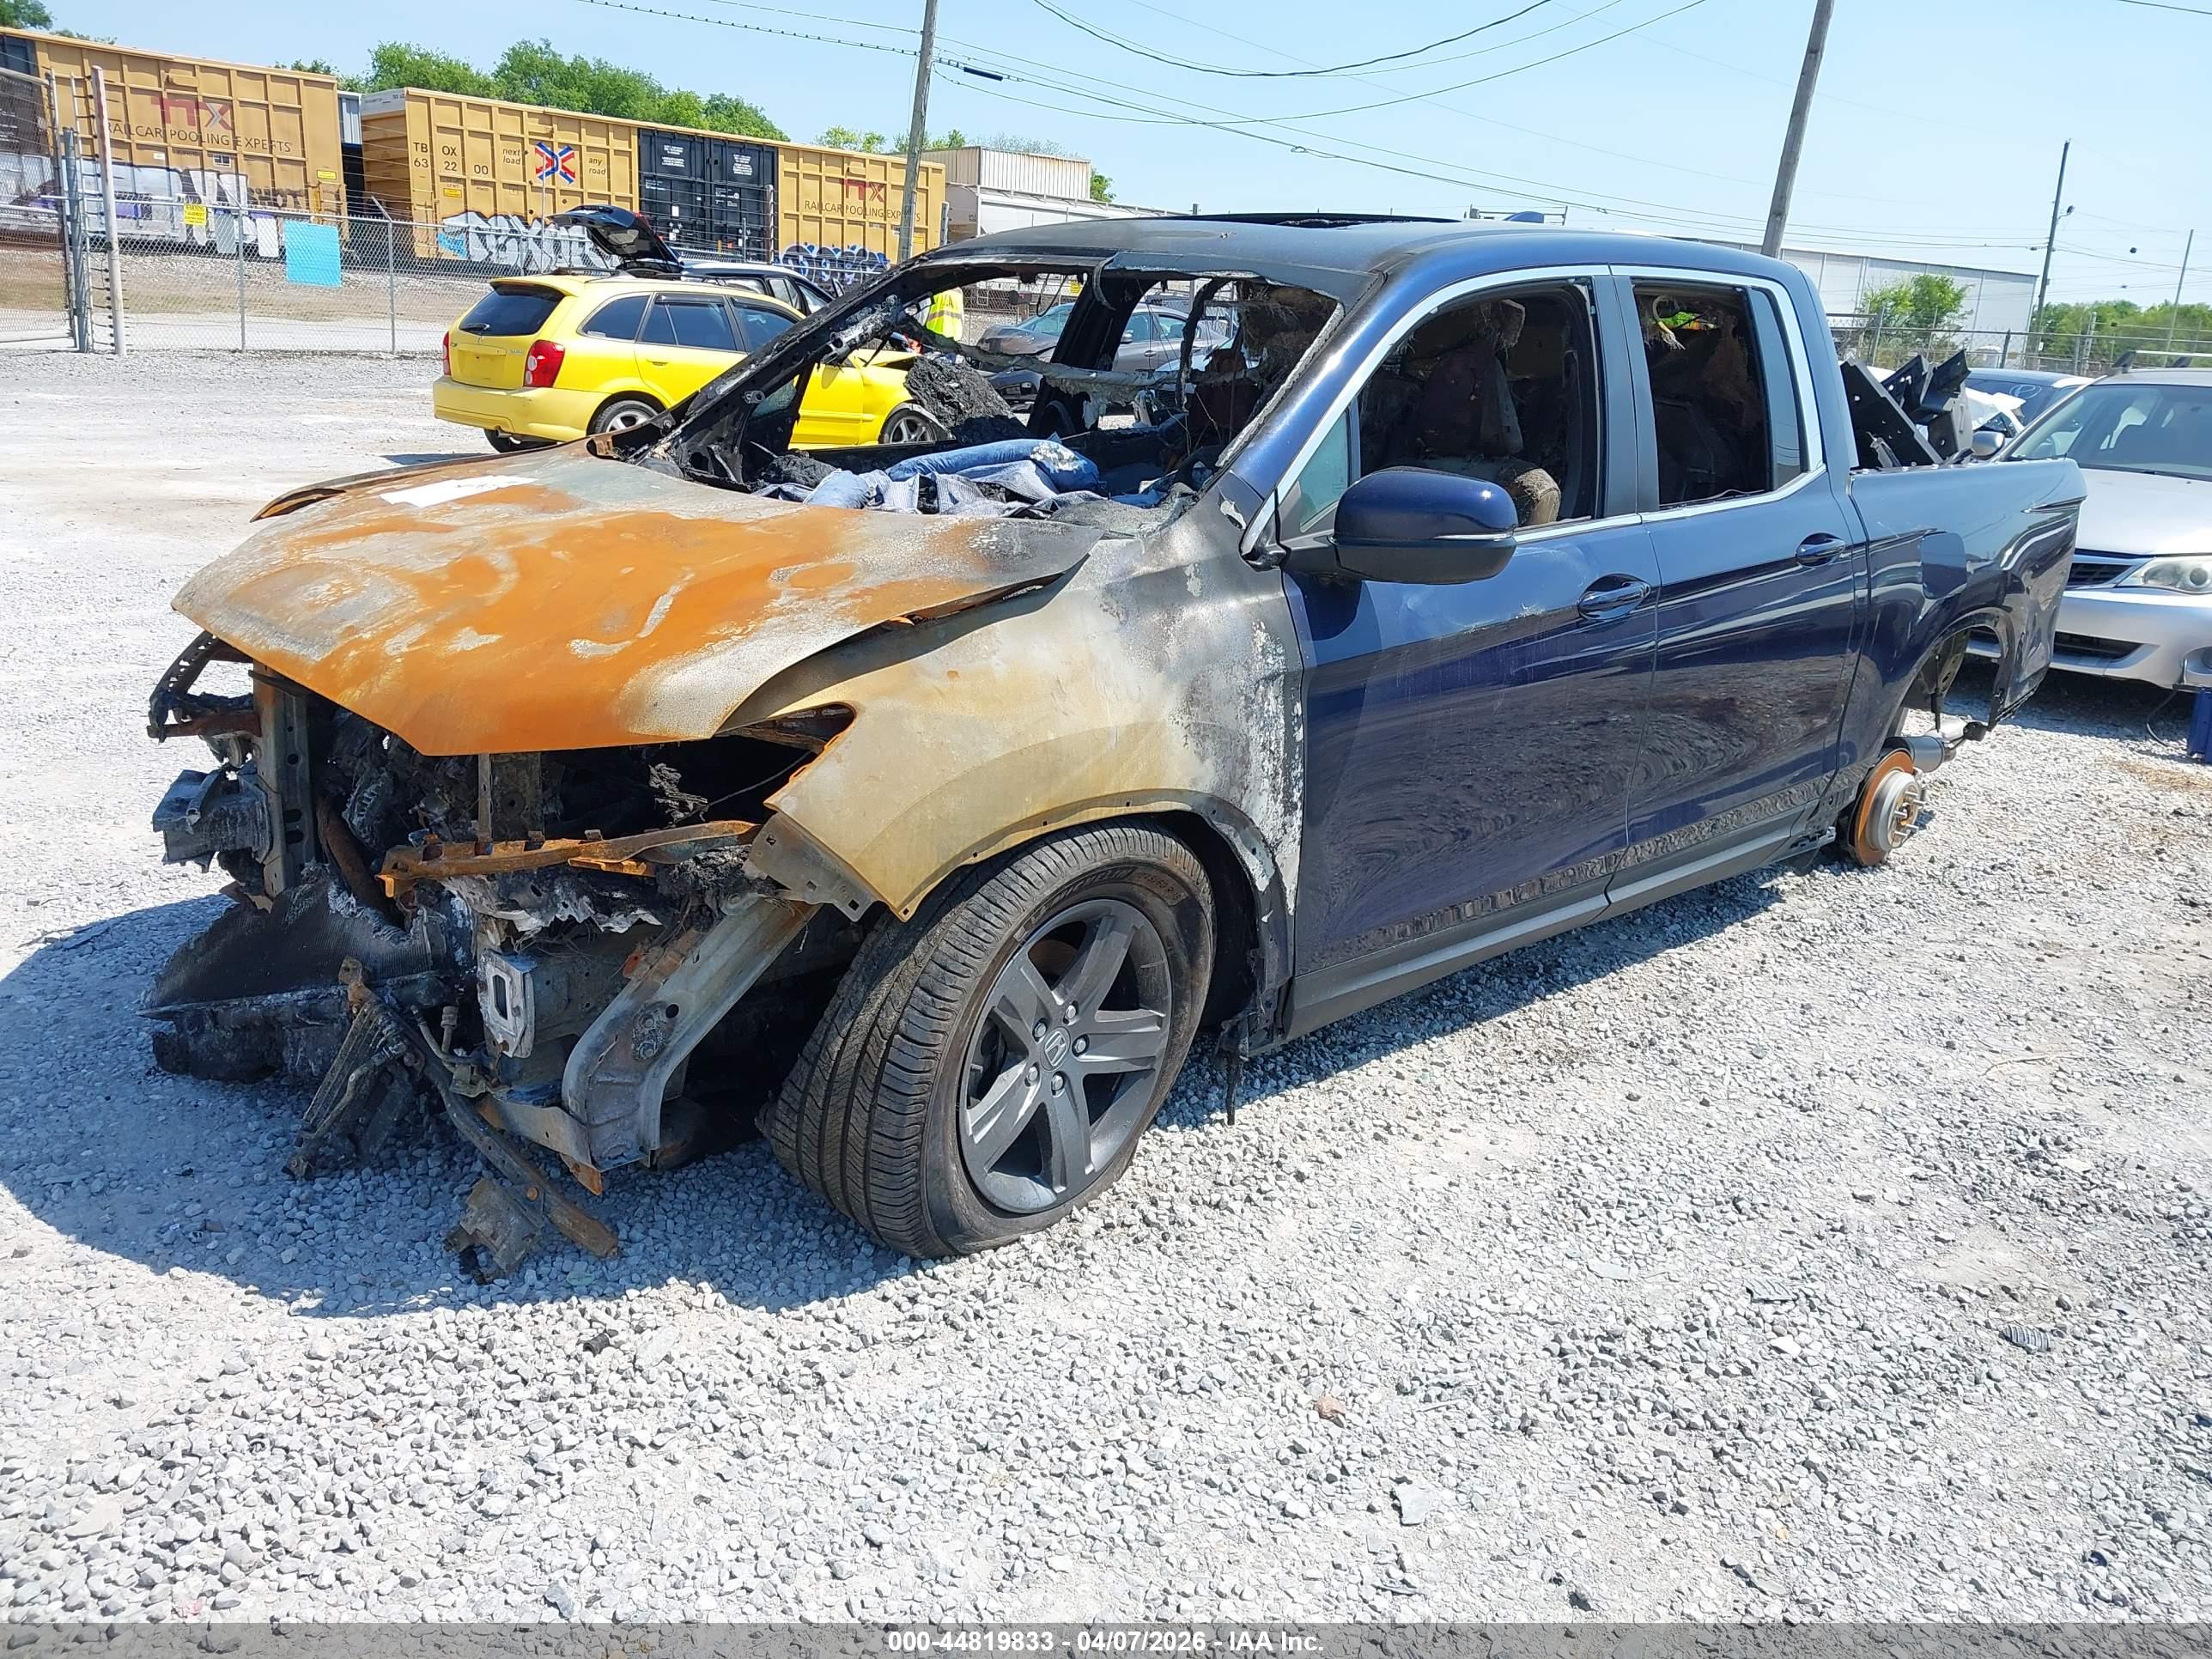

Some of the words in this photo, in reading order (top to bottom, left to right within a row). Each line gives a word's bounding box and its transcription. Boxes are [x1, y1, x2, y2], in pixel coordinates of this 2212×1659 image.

[171, 128, 230, 146] POOLING
[413, 142, 428, 153] TB
[441, 145, 458, 156] OX
[502, 148, 520, 156] next
[413, 158, 428, 168] 63
[443, 161, 458, 172] 22
[473, 164, 489, 175] 00
[503, 156, 520, 166] load
[588, 157, 603, 167] any
